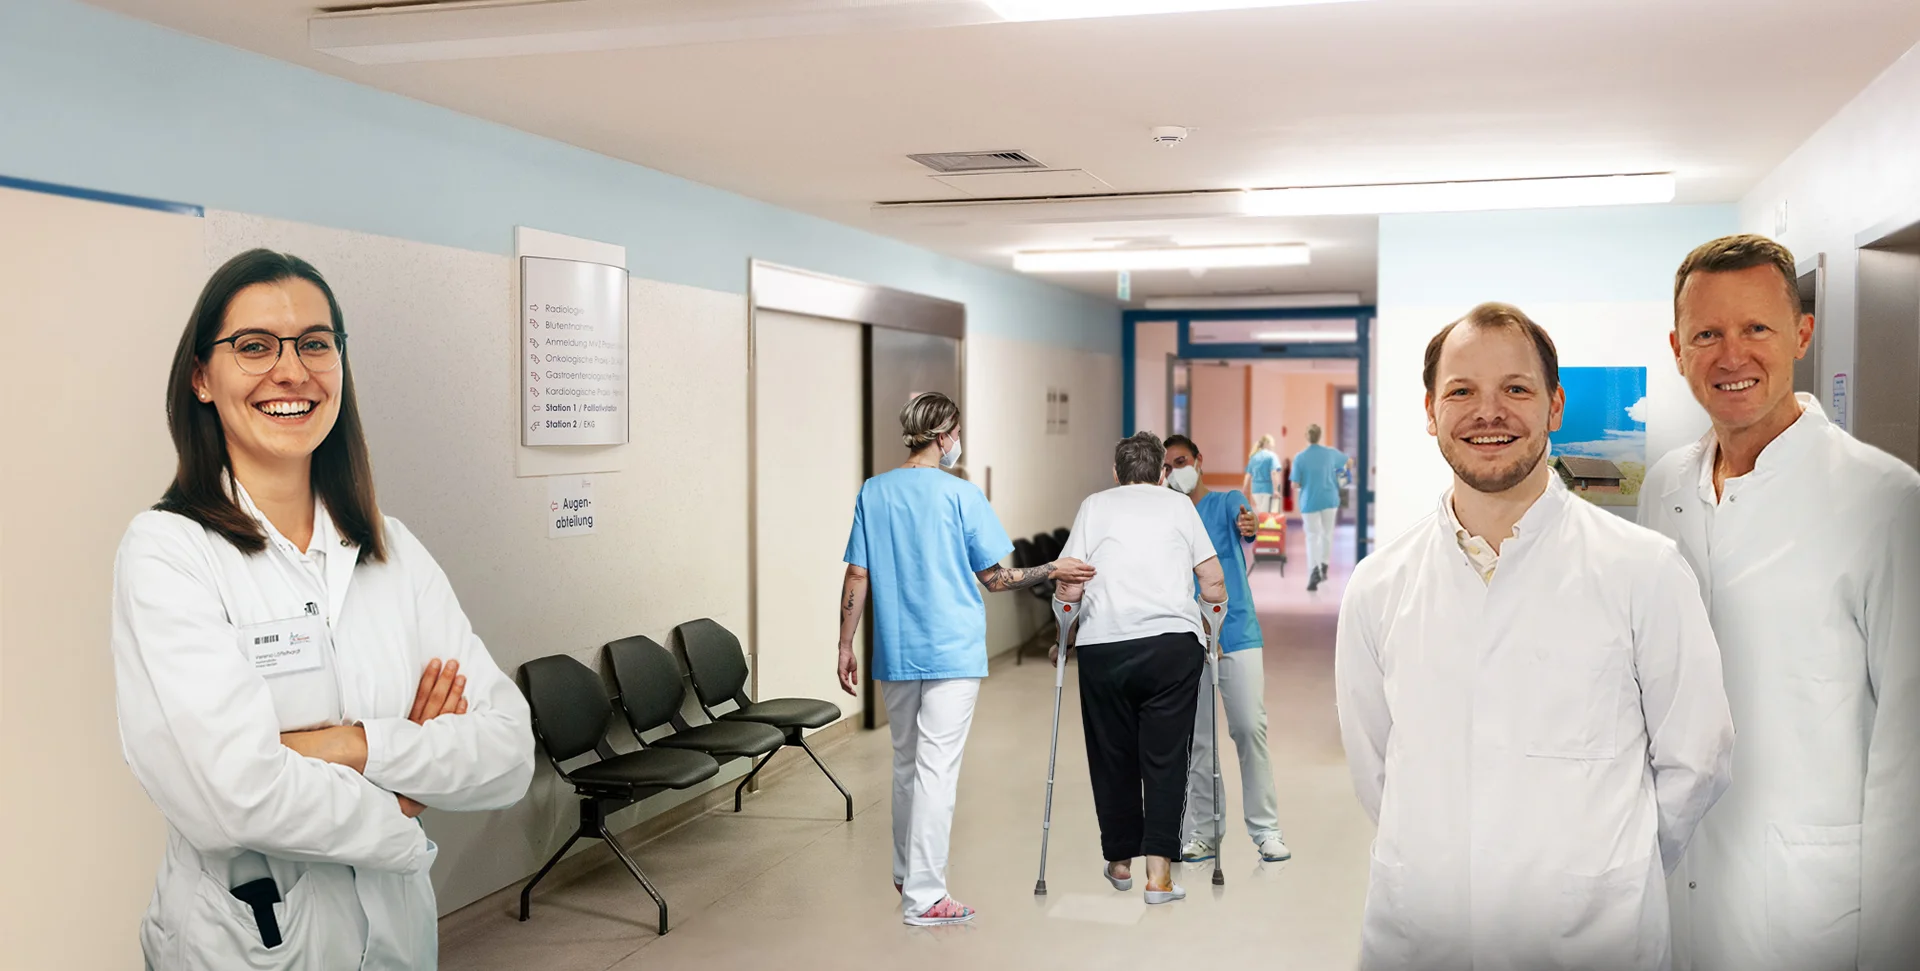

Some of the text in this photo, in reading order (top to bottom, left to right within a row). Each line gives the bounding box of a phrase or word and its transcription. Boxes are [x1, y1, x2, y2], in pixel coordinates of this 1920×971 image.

[545, 338, 587, 349] Anmeldung
[545, 354, 593, 365] Onkologische
[545, 387, 596, 398] Kardiologische
[545, 403, 571, 412] Station
[573, 404, 577, 412] 1
[545, 420, 572, 429] Station
[572, 420, 577, 428] 2
[563, 498, 591, 512] Augen-
[556, 515, 593, 528] abteilung
